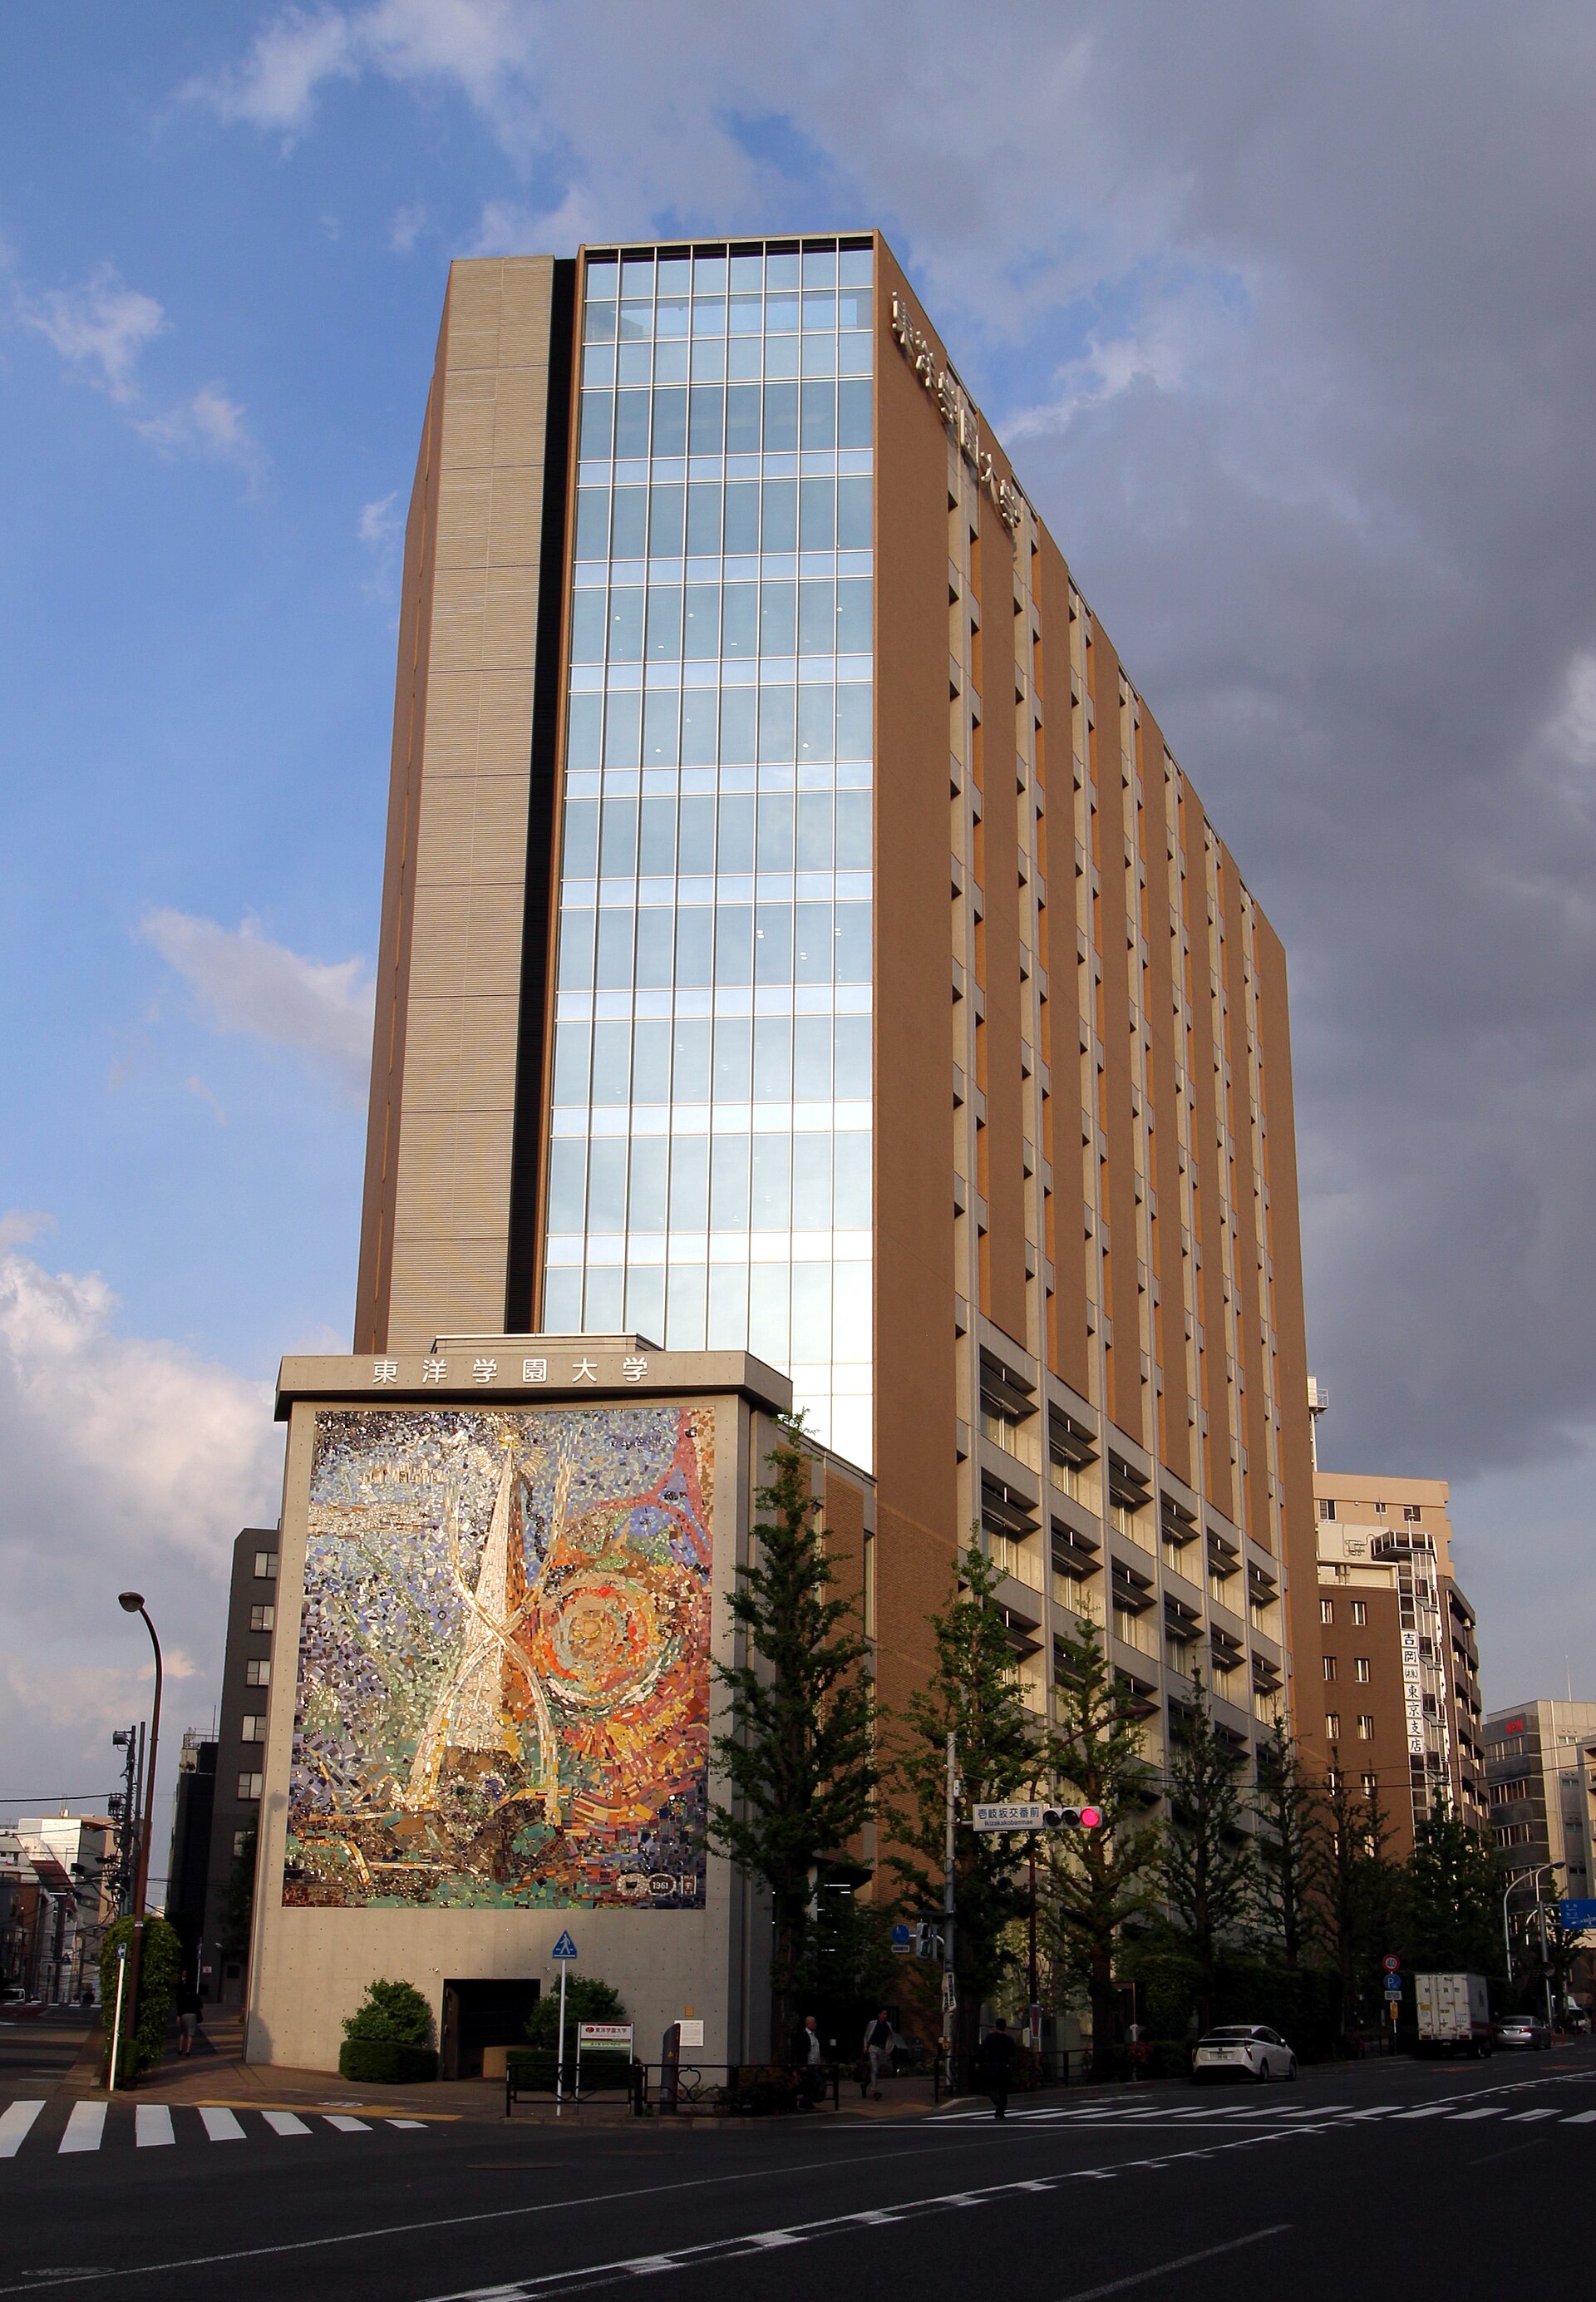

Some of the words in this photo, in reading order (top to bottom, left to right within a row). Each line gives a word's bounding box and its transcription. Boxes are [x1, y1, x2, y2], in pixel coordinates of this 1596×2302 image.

[372, 1356, 648, 1383] 東洋学園大学
[978, 1807, 1039, 1819] 壱岐坂交番前
[1387, 1959, 1397, 1969] 40
